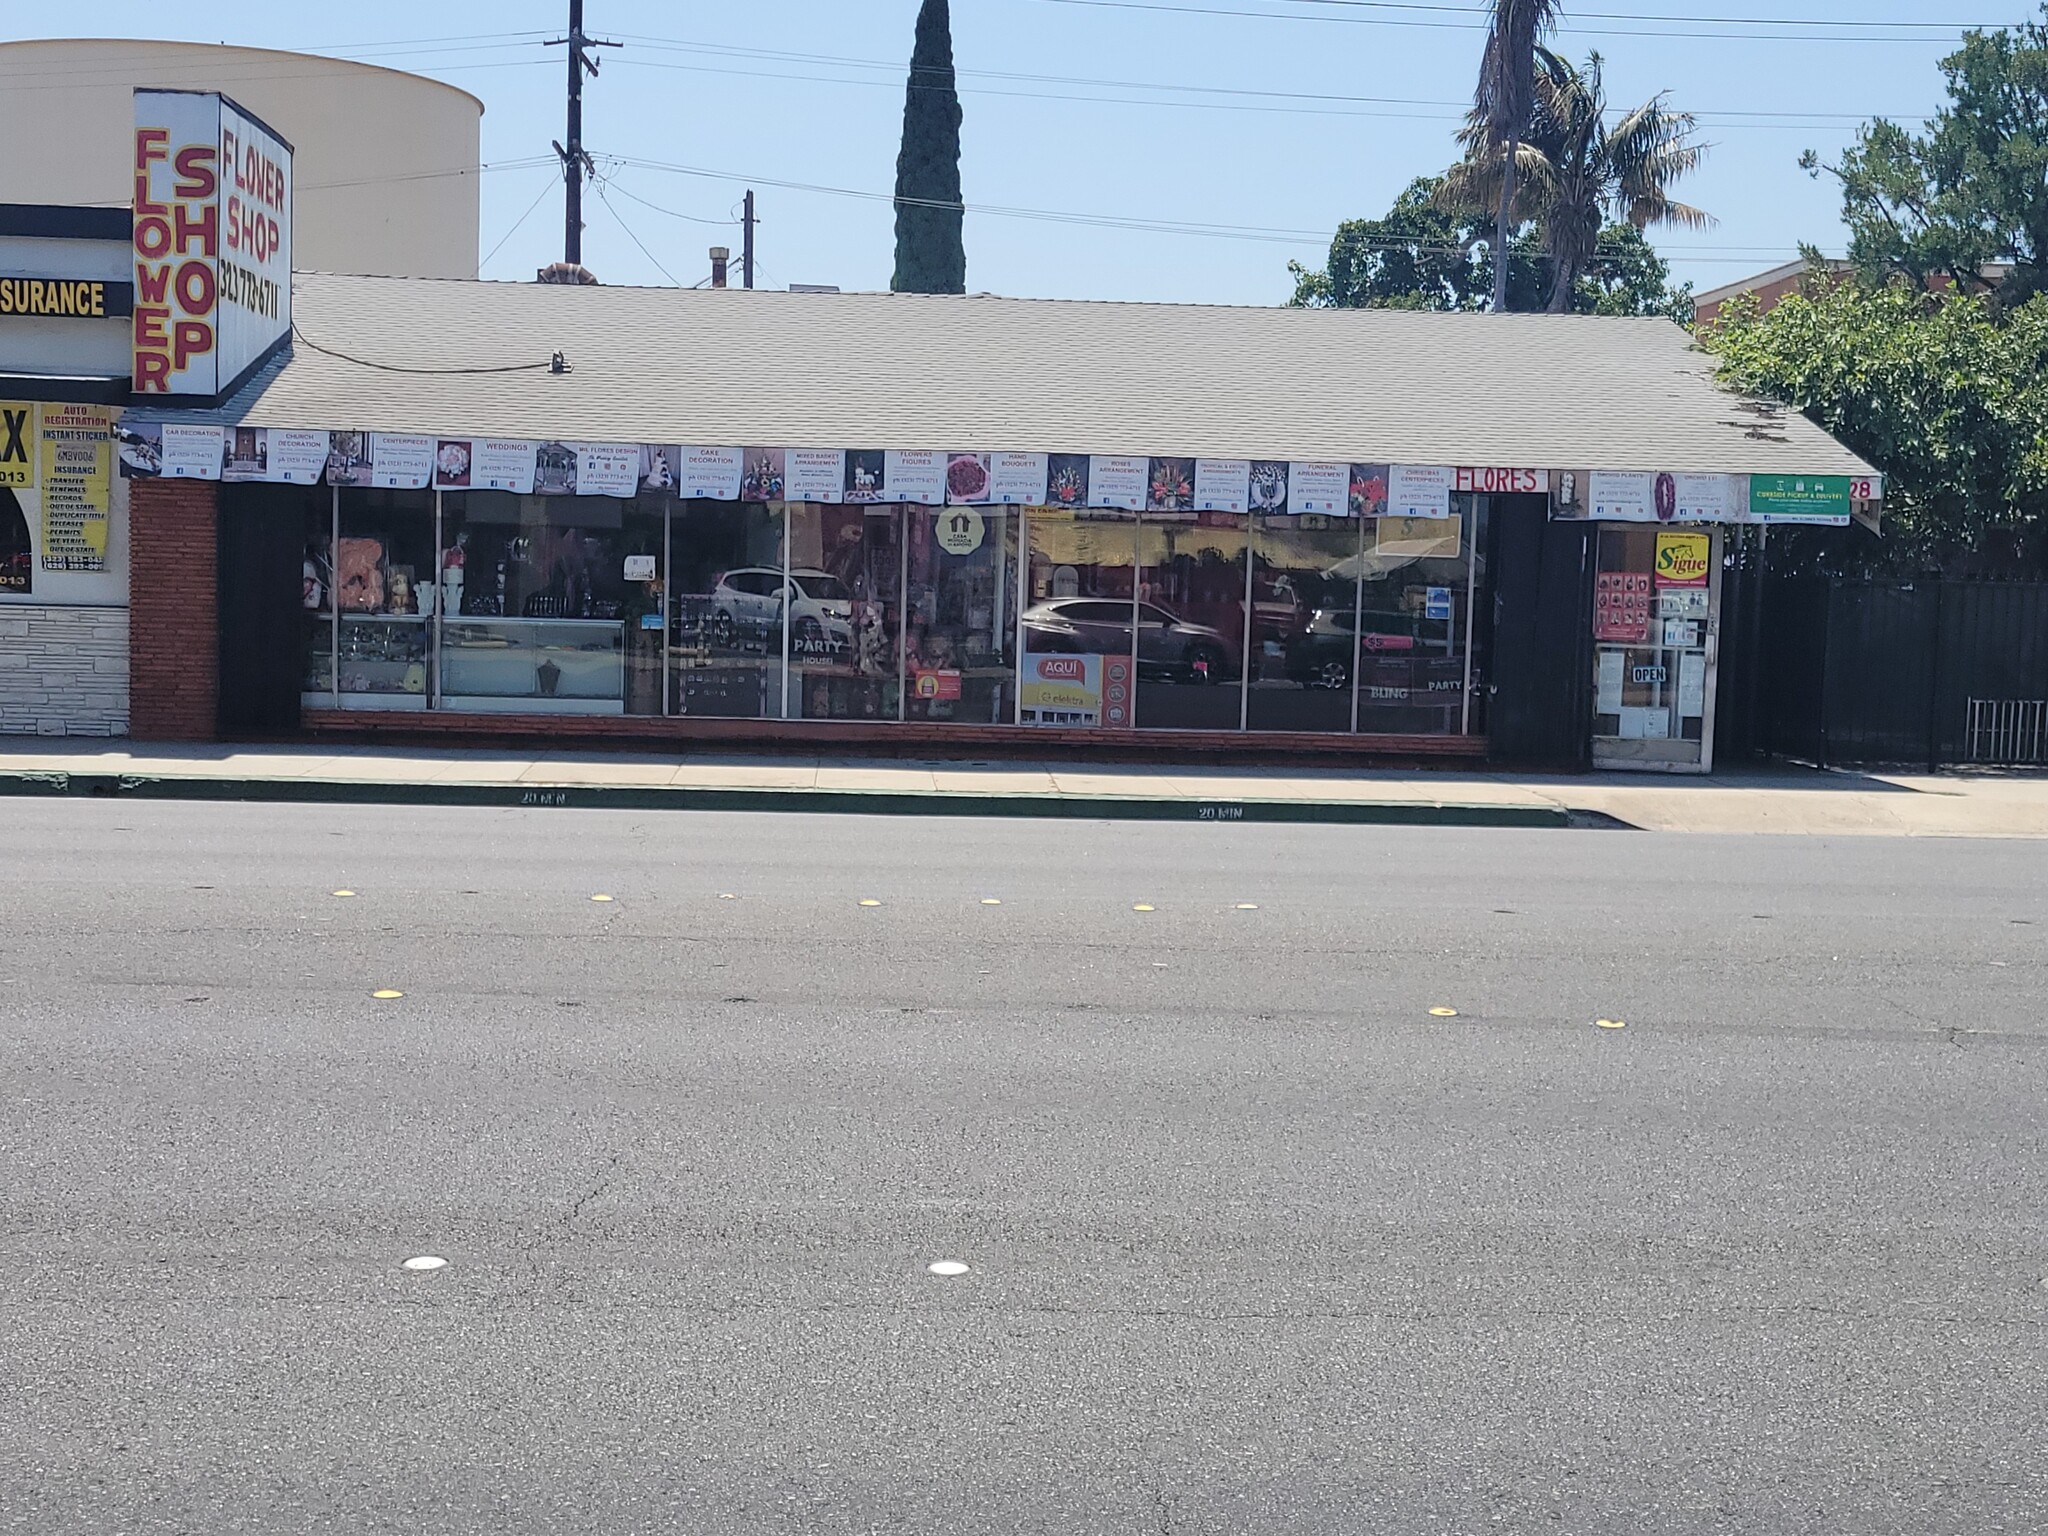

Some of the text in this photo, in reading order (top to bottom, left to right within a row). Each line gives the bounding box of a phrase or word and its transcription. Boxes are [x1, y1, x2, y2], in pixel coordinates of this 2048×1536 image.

[222, 128, 285, 215] FLOWER
[227, 194, 279, 264] SHOP
[135, 127, 171, 392] FLOWER
[172, 143, 217, 373] SHOP
[220, 258, 238, 304] 323
[0, 279, 104, 316] SURANCE
[63, 406, 87, 416] AUTO
[44, 415, 107, 427] REGISTRATION
[0, 409, 28, 464] X
[43, 429, 108, 441] INSTANT STICKER
[382, 438, 428, 446] CENTERPIECES
[278, 440, 321, 448] DECORATION
[486, 442, 528, 451] WEDDINGS
[54, 465, 97, 475] INSURANCE
[1456, 467, 1537, 492] FLORES
[1657, 547, 1706, 575] Sigue
[0, 576, 26, 585] 013
[794, 639, 843, 653] PARTY
[1045, 660, 1078, 674] AQUÍ
[1634, 667, 1664, 682] OPEN
[1428, 680, 1462, 691] PARTY
[1370, 687, 1409, 699] BLING
[1199, 807, 1243, 819] 20 MIN
